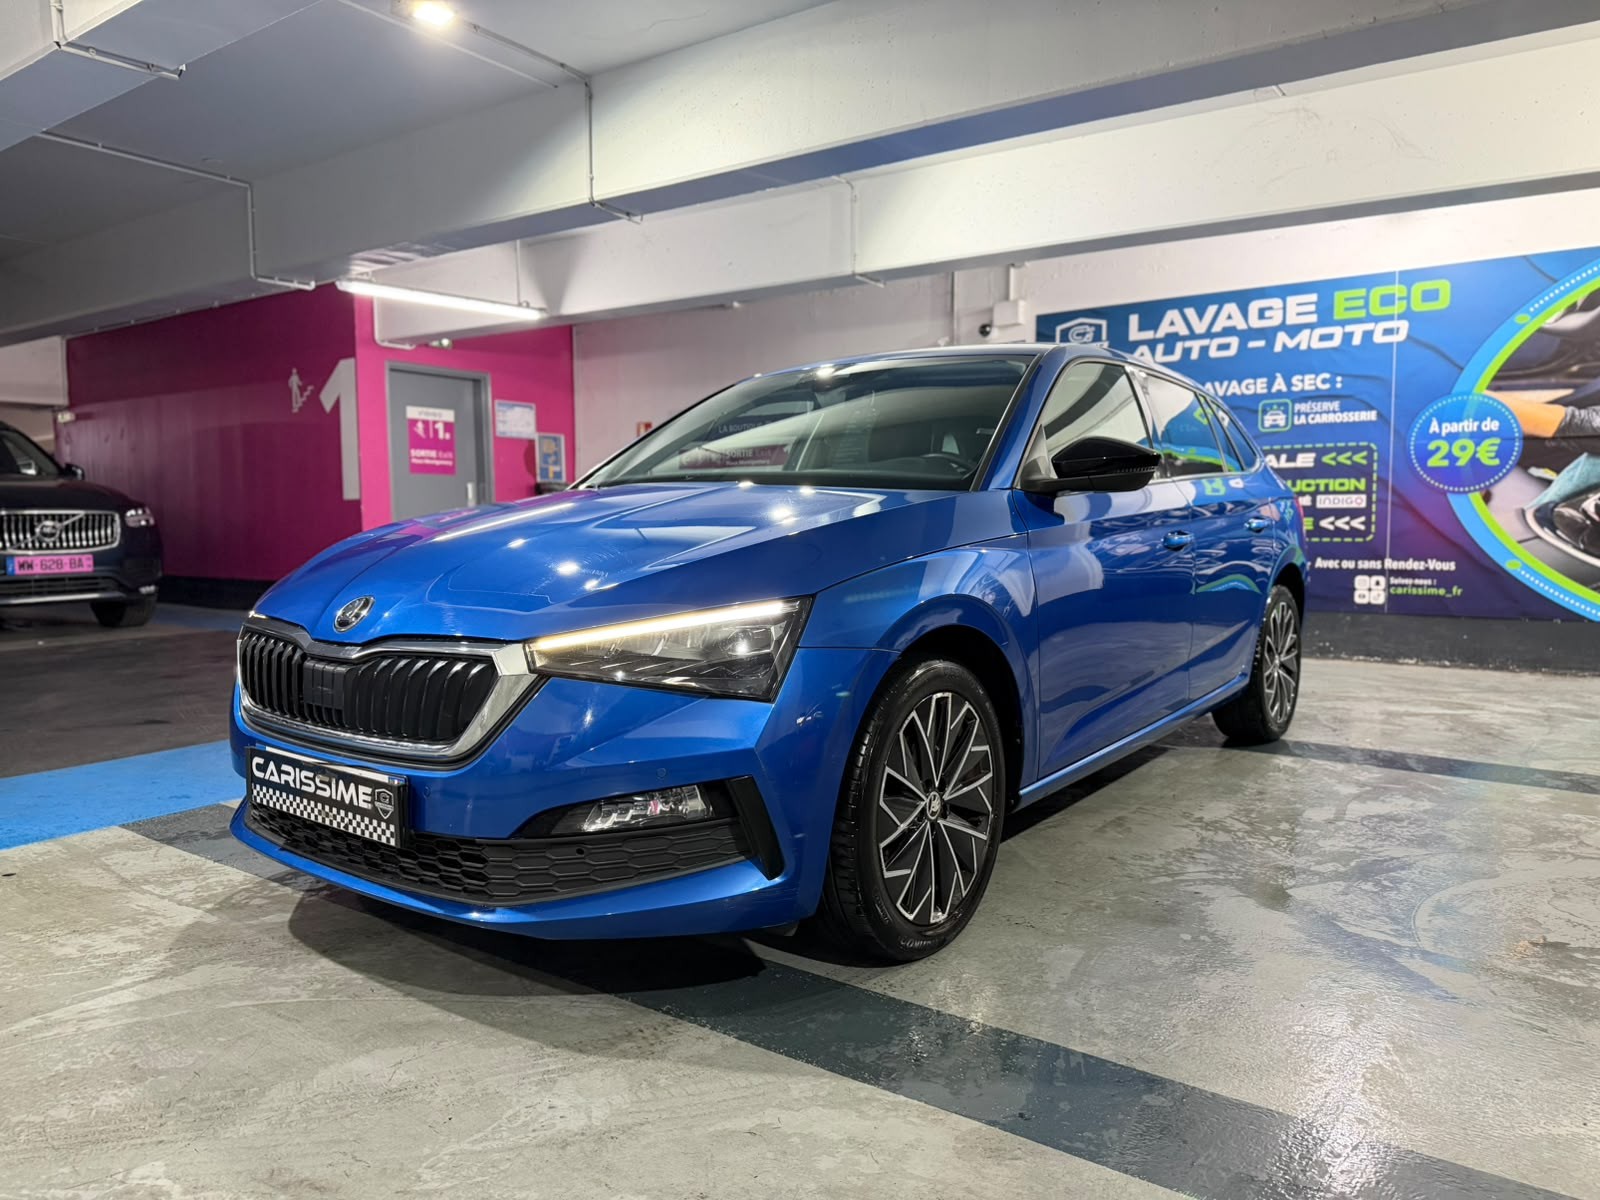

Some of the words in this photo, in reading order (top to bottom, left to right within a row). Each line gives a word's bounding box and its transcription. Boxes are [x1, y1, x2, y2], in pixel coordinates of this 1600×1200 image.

[1128, 293, 1318, 342] LAVAGE
[1333, 279, 1452, 320] ECO
[1131, 336, 1241, 364] AUTO
[1273, 320, 1410, 353] MOTO
[1271, 373, 1288, 393] À
[1291, 373, 1332, 393] SEC
[1294, 401, 1341, 414] PRÉSERVE
[1294, 414, 1309, 426] LA
[1310, 410, 1378, 424] CARROSSERIE
[1428, 417, 1440, 435] À
[1441, 418, 1480, 437] partir
[1481, 416, 1500, 432] de
[319, 357, 361, 501] 1
[1427, 437, 1501, 467] 29€
[1319, 494, 1364, 506] INDIGO
[1315, 557, 1340, 570] Avec
[1341, 560, 1356, 570] ou
[1357, 560, 1382, 571] sans
[1384, 557, 1456, 571] Rendez-Vous
[1389, 585, 1463, 598] carissime_fr
[252, 756, 373, 810] CARISSIME
